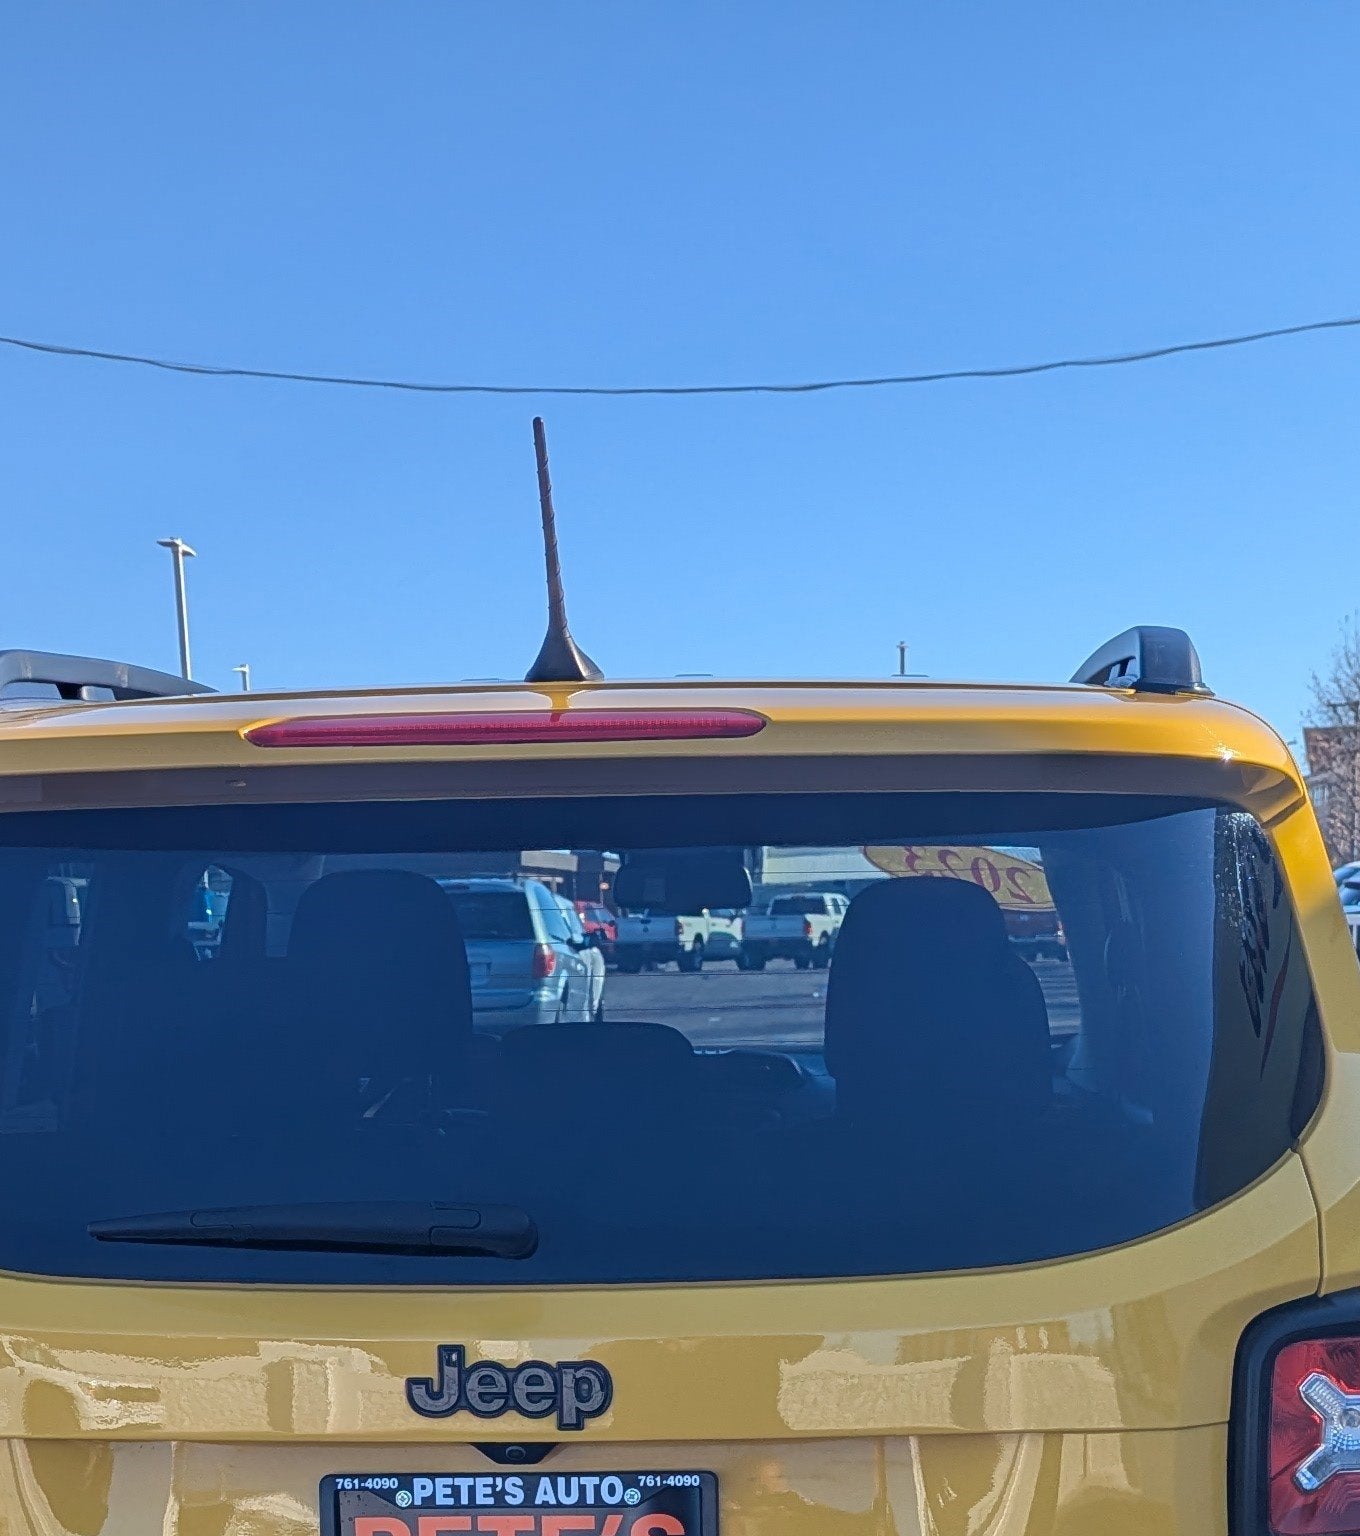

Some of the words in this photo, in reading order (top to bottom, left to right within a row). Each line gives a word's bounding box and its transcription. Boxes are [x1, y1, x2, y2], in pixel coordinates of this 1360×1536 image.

[406, 1344, 613, 1431] Jeep
[335, 1477, 399, 1490] 761-4090
[413, 1476, 525, 1506] PETE'S
[535, 1475, 624, 1505] AUTO
[638, 1475, 701, 1488] 761-4090
